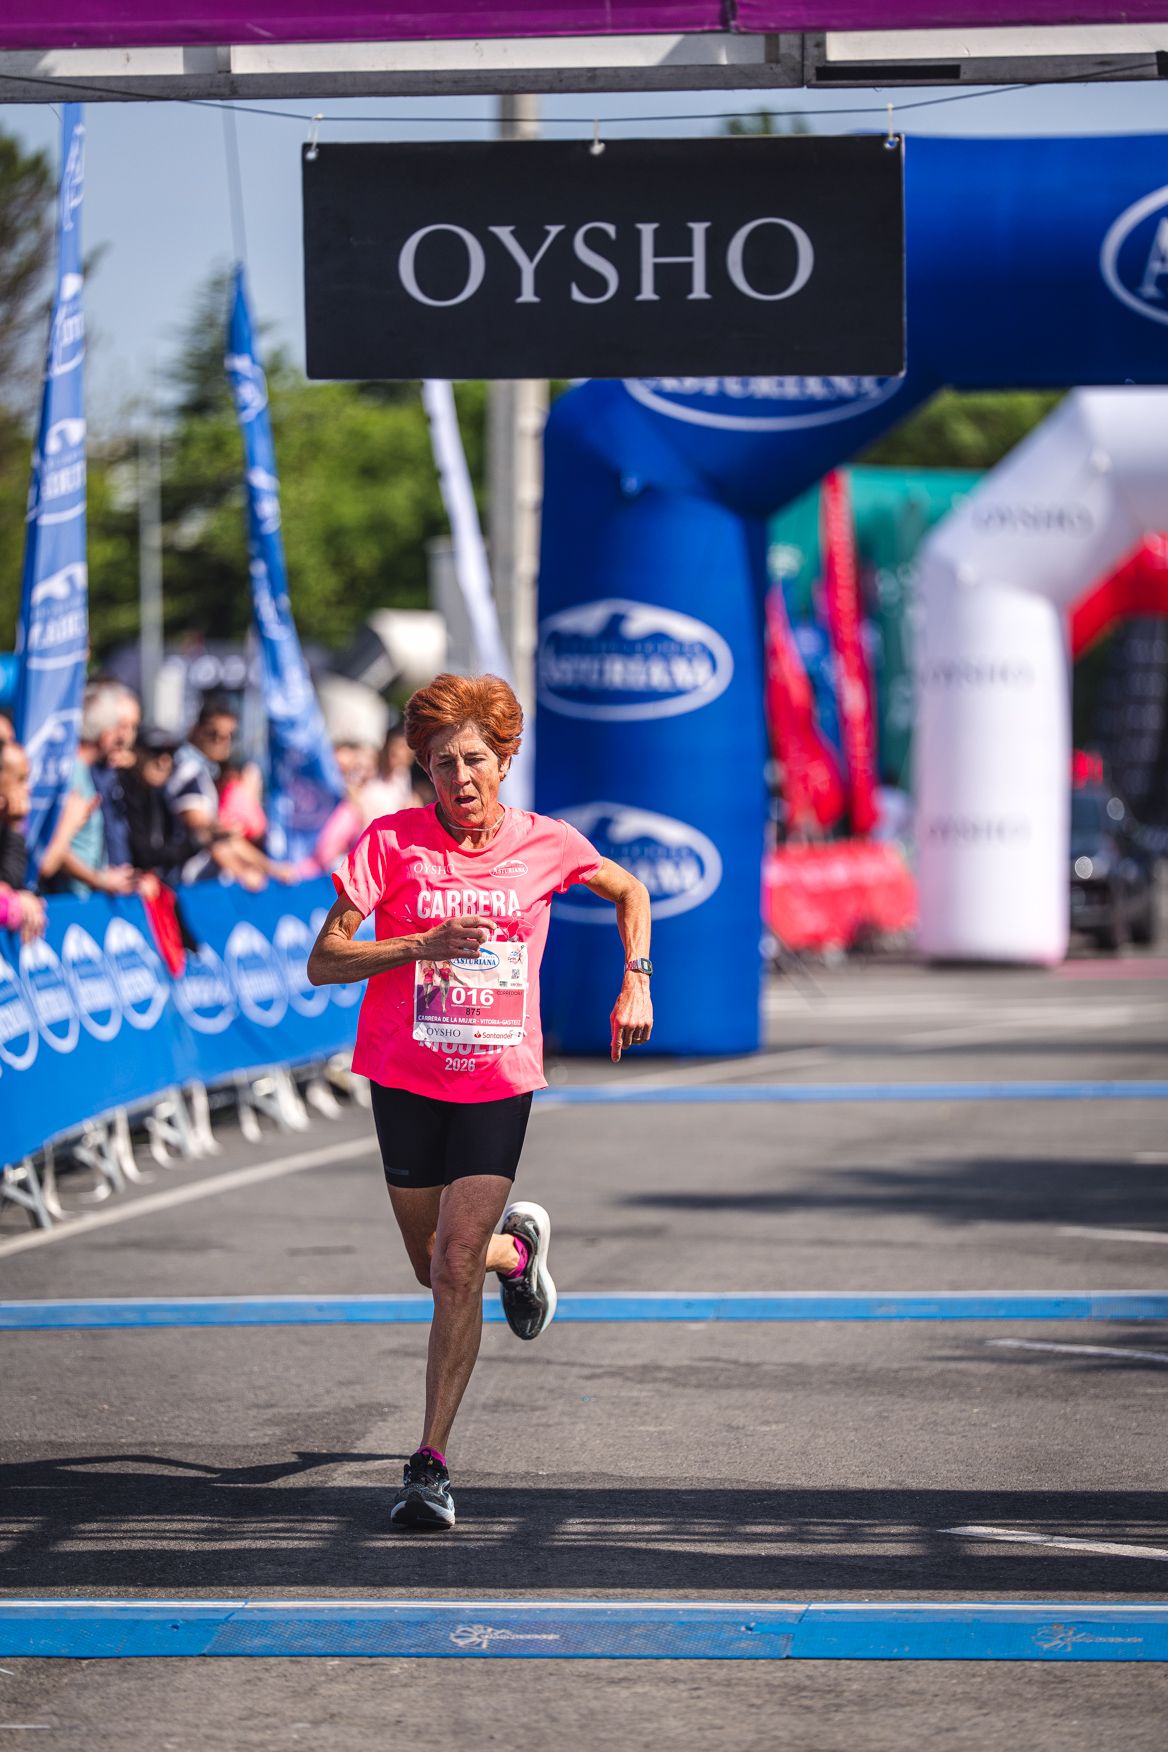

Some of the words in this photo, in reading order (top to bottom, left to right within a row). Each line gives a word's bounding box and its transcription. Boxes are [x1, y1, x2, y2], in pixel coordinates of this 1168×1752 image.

[398, 217, 815, 307] OYSHO
[414, 862, 455, 874] OYSHO
[417, 889, 521, 918] CARRERA
[453, 957, 497, 966] ASTURIANA
[451, 987, 494, 1006] 016
[465, 1008, 481, 1016] 875
[426, 1027, 461, 1038] OYSHO
[482, 1031, 513, 1039] Santander
[444, 1057, 476, 1072] 2026
